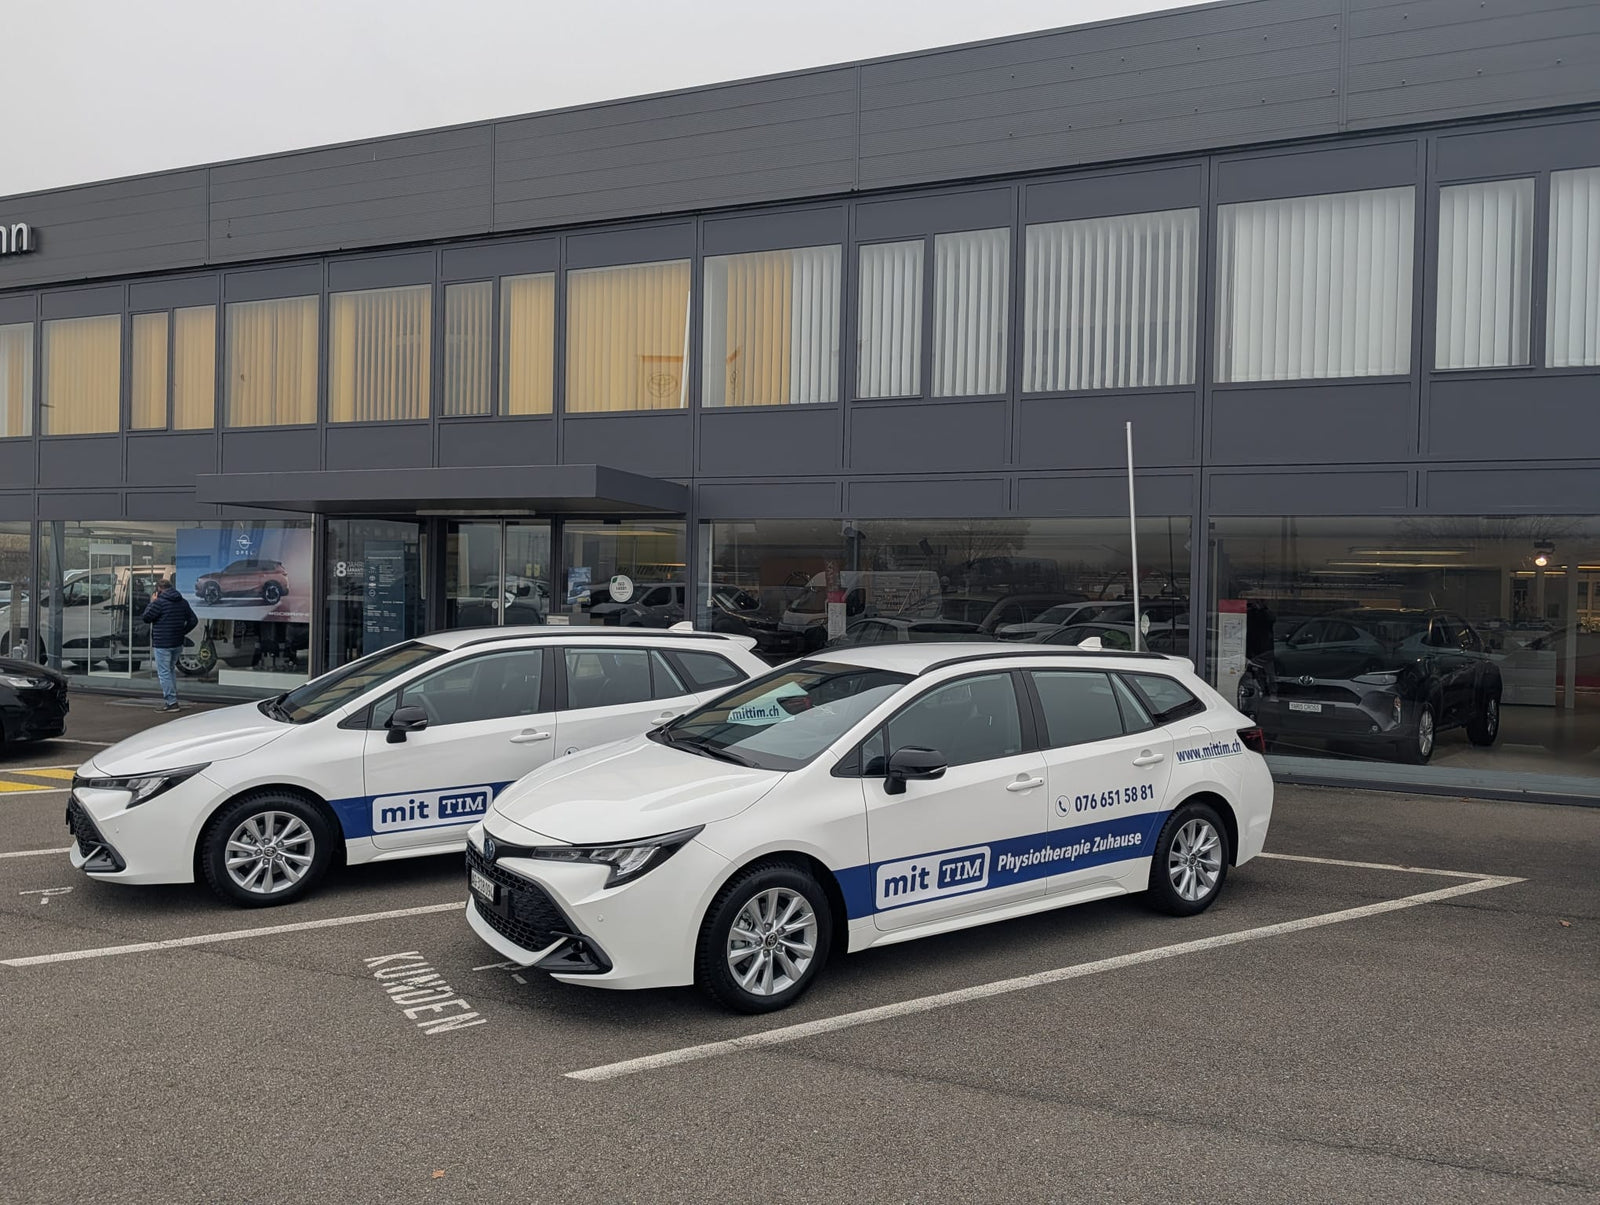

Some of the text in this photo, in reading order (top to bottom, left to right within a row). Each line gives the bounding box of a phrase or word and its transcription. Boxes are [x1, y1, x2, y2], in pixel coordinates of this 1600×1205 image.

[336, 561, 347, 577] 8
[1176, 738, 1242, 762] www.mittim.ch
[381, 796, 484, 824] mit TIM
[1075, 784, 1154, 812] 076 651 58 81
[883, 832, 1142, 898] mit TIM Physiotherapie Zuhause
[363, 950, 487, 1035] KUNDEN
